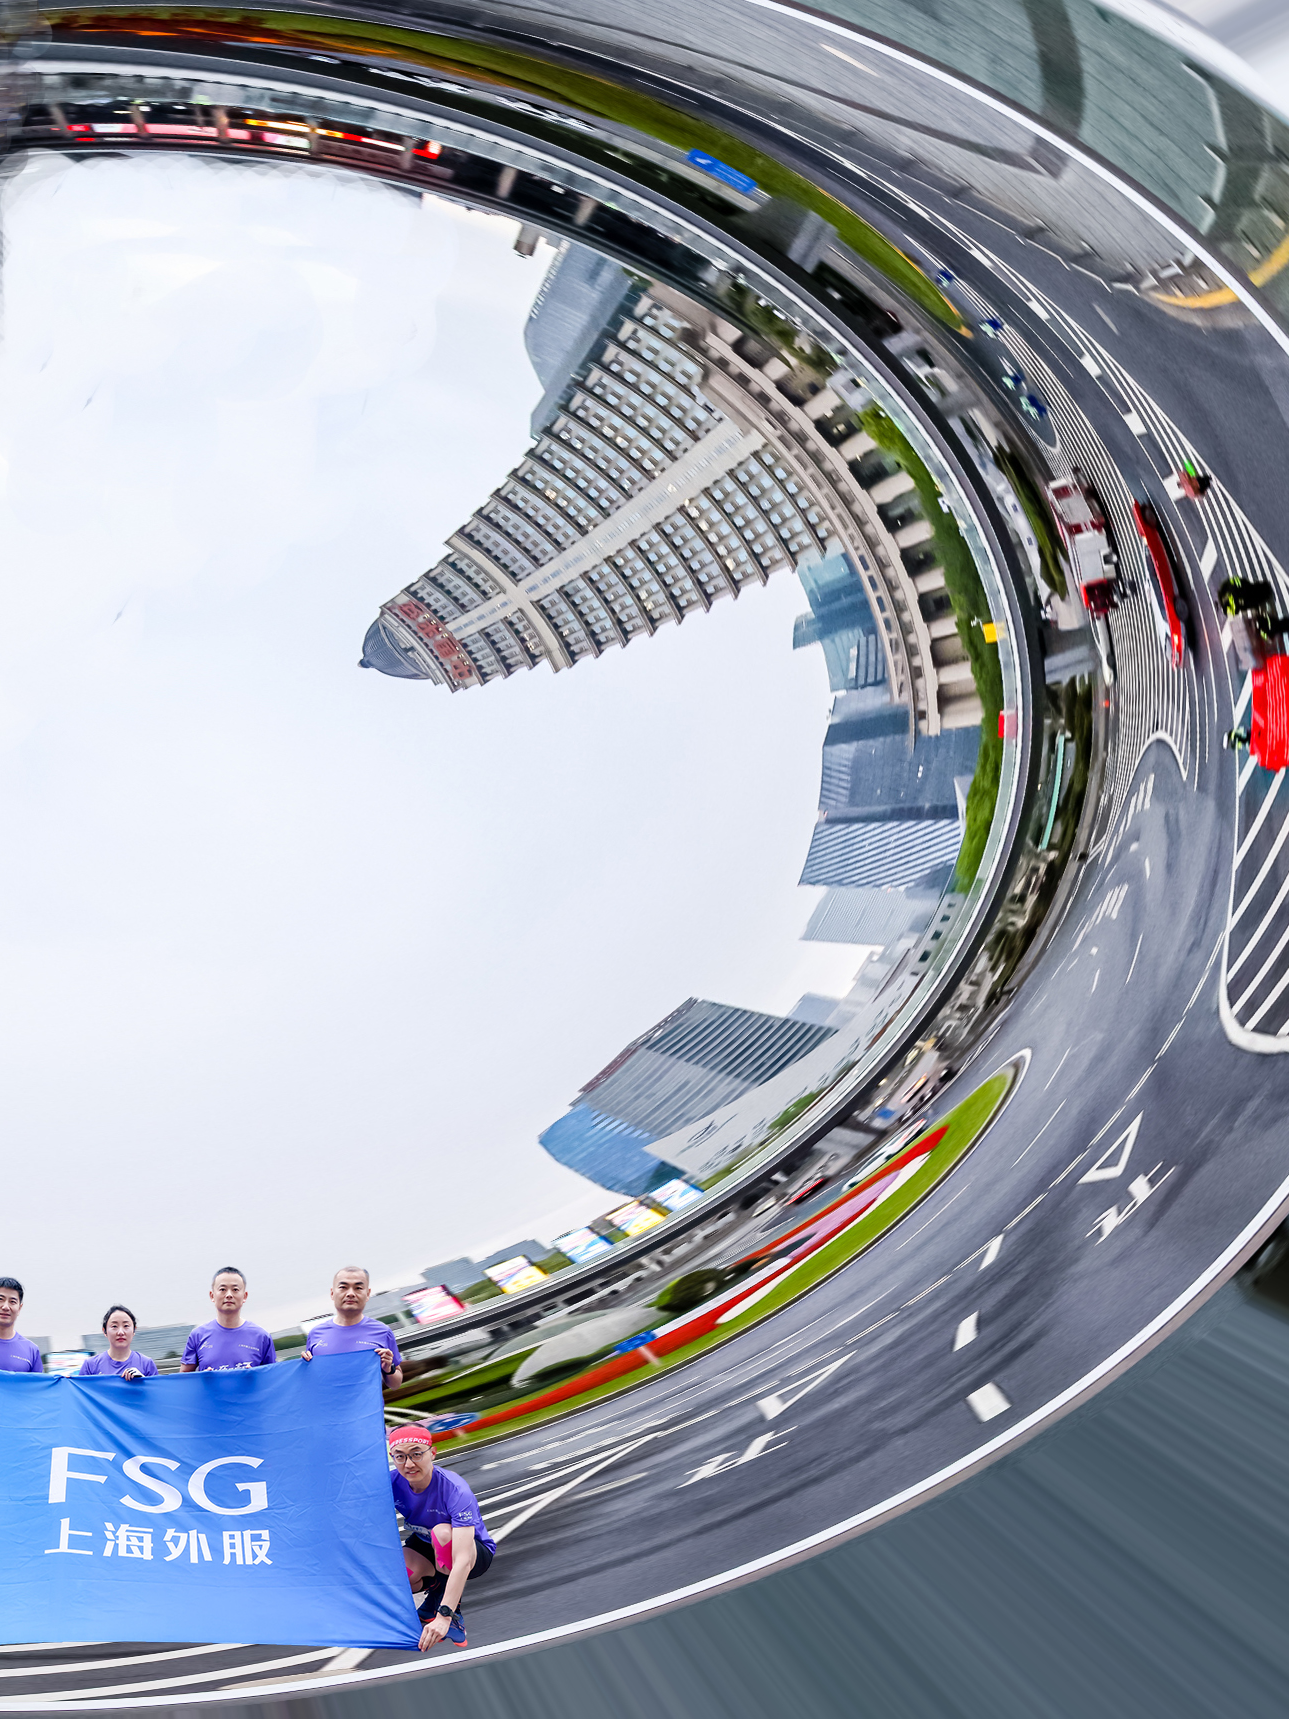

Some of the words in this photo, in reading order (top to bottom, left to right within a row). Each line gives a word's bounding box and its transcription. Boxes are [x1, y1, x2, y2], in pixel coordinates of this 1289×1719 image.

[48, 1446, 268, 1515] FSG
[44, 1517, 273, 1565] 上海外服
